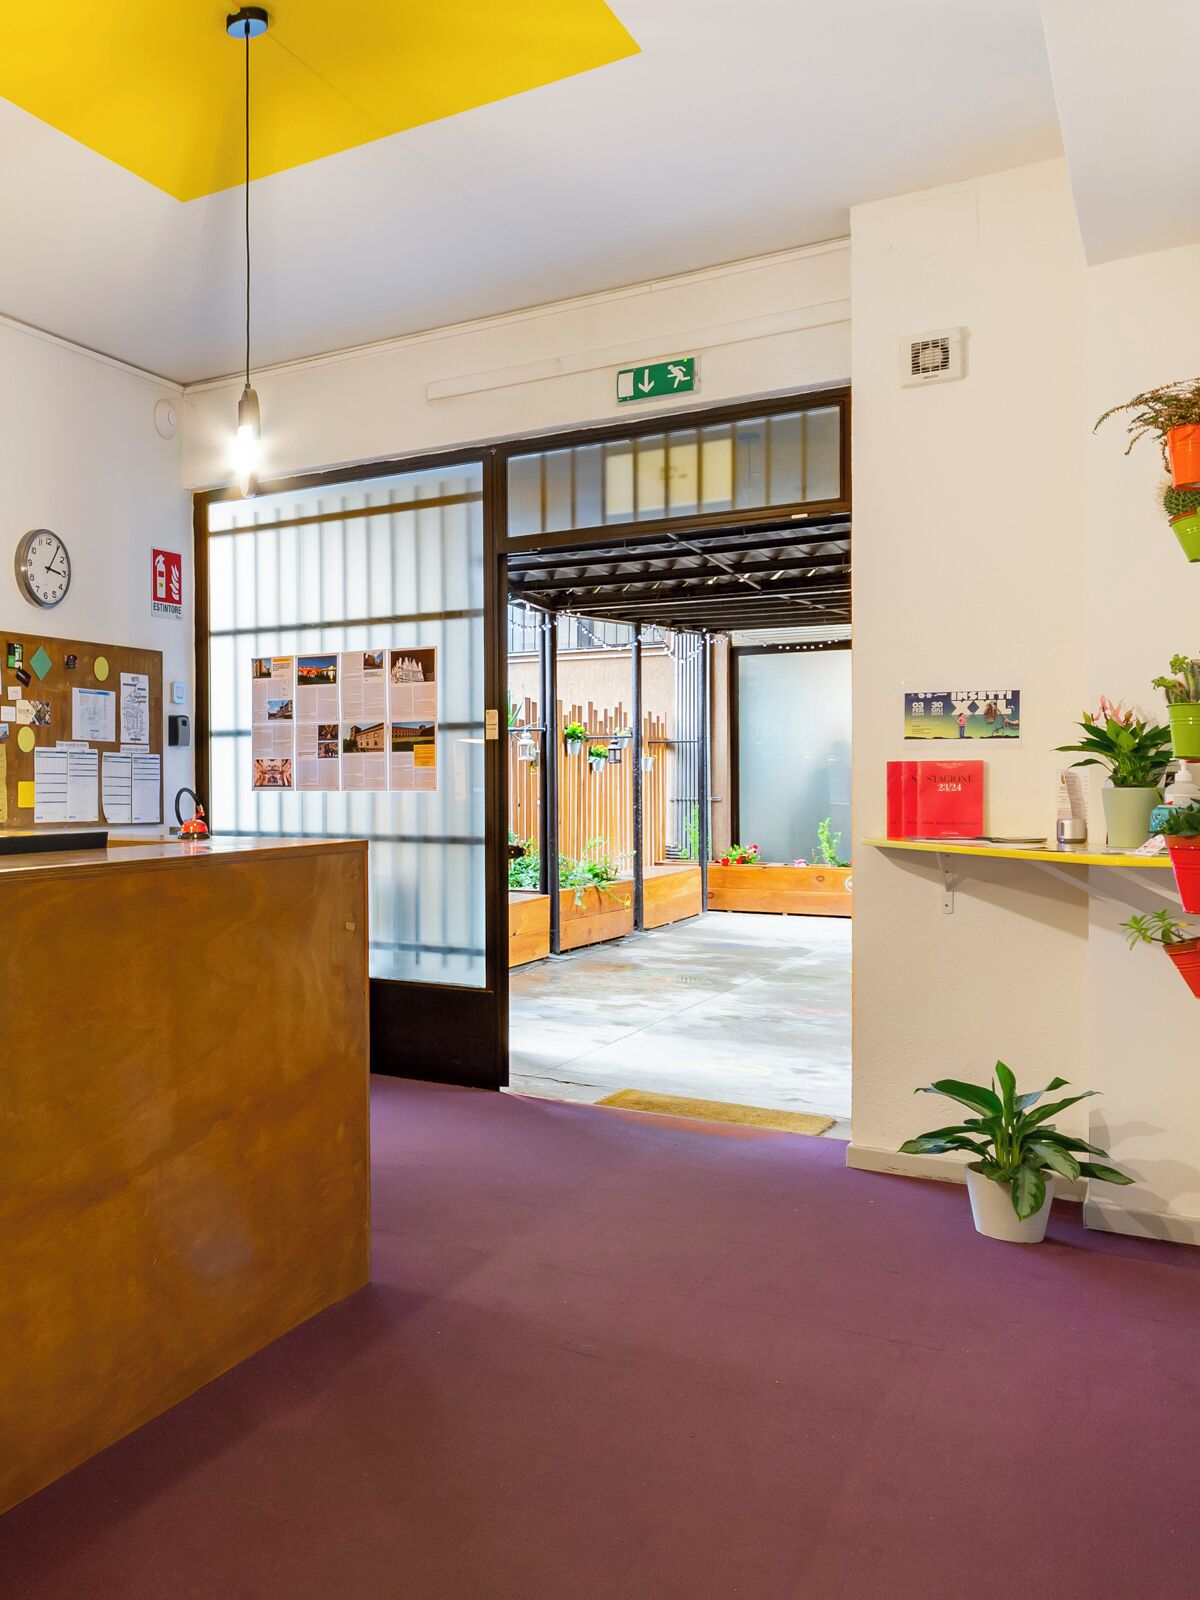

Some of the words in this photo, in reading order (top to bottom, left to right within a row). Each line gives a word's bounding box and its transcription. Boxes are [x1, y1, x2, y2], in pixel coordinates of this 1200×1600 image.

[46, 538, 52, 546] 12
[154, 602, 182, 614] ESTINTORE
[951, 690, 1012, 700] INSETTI
[938, 784, 962, 792] 23/24
